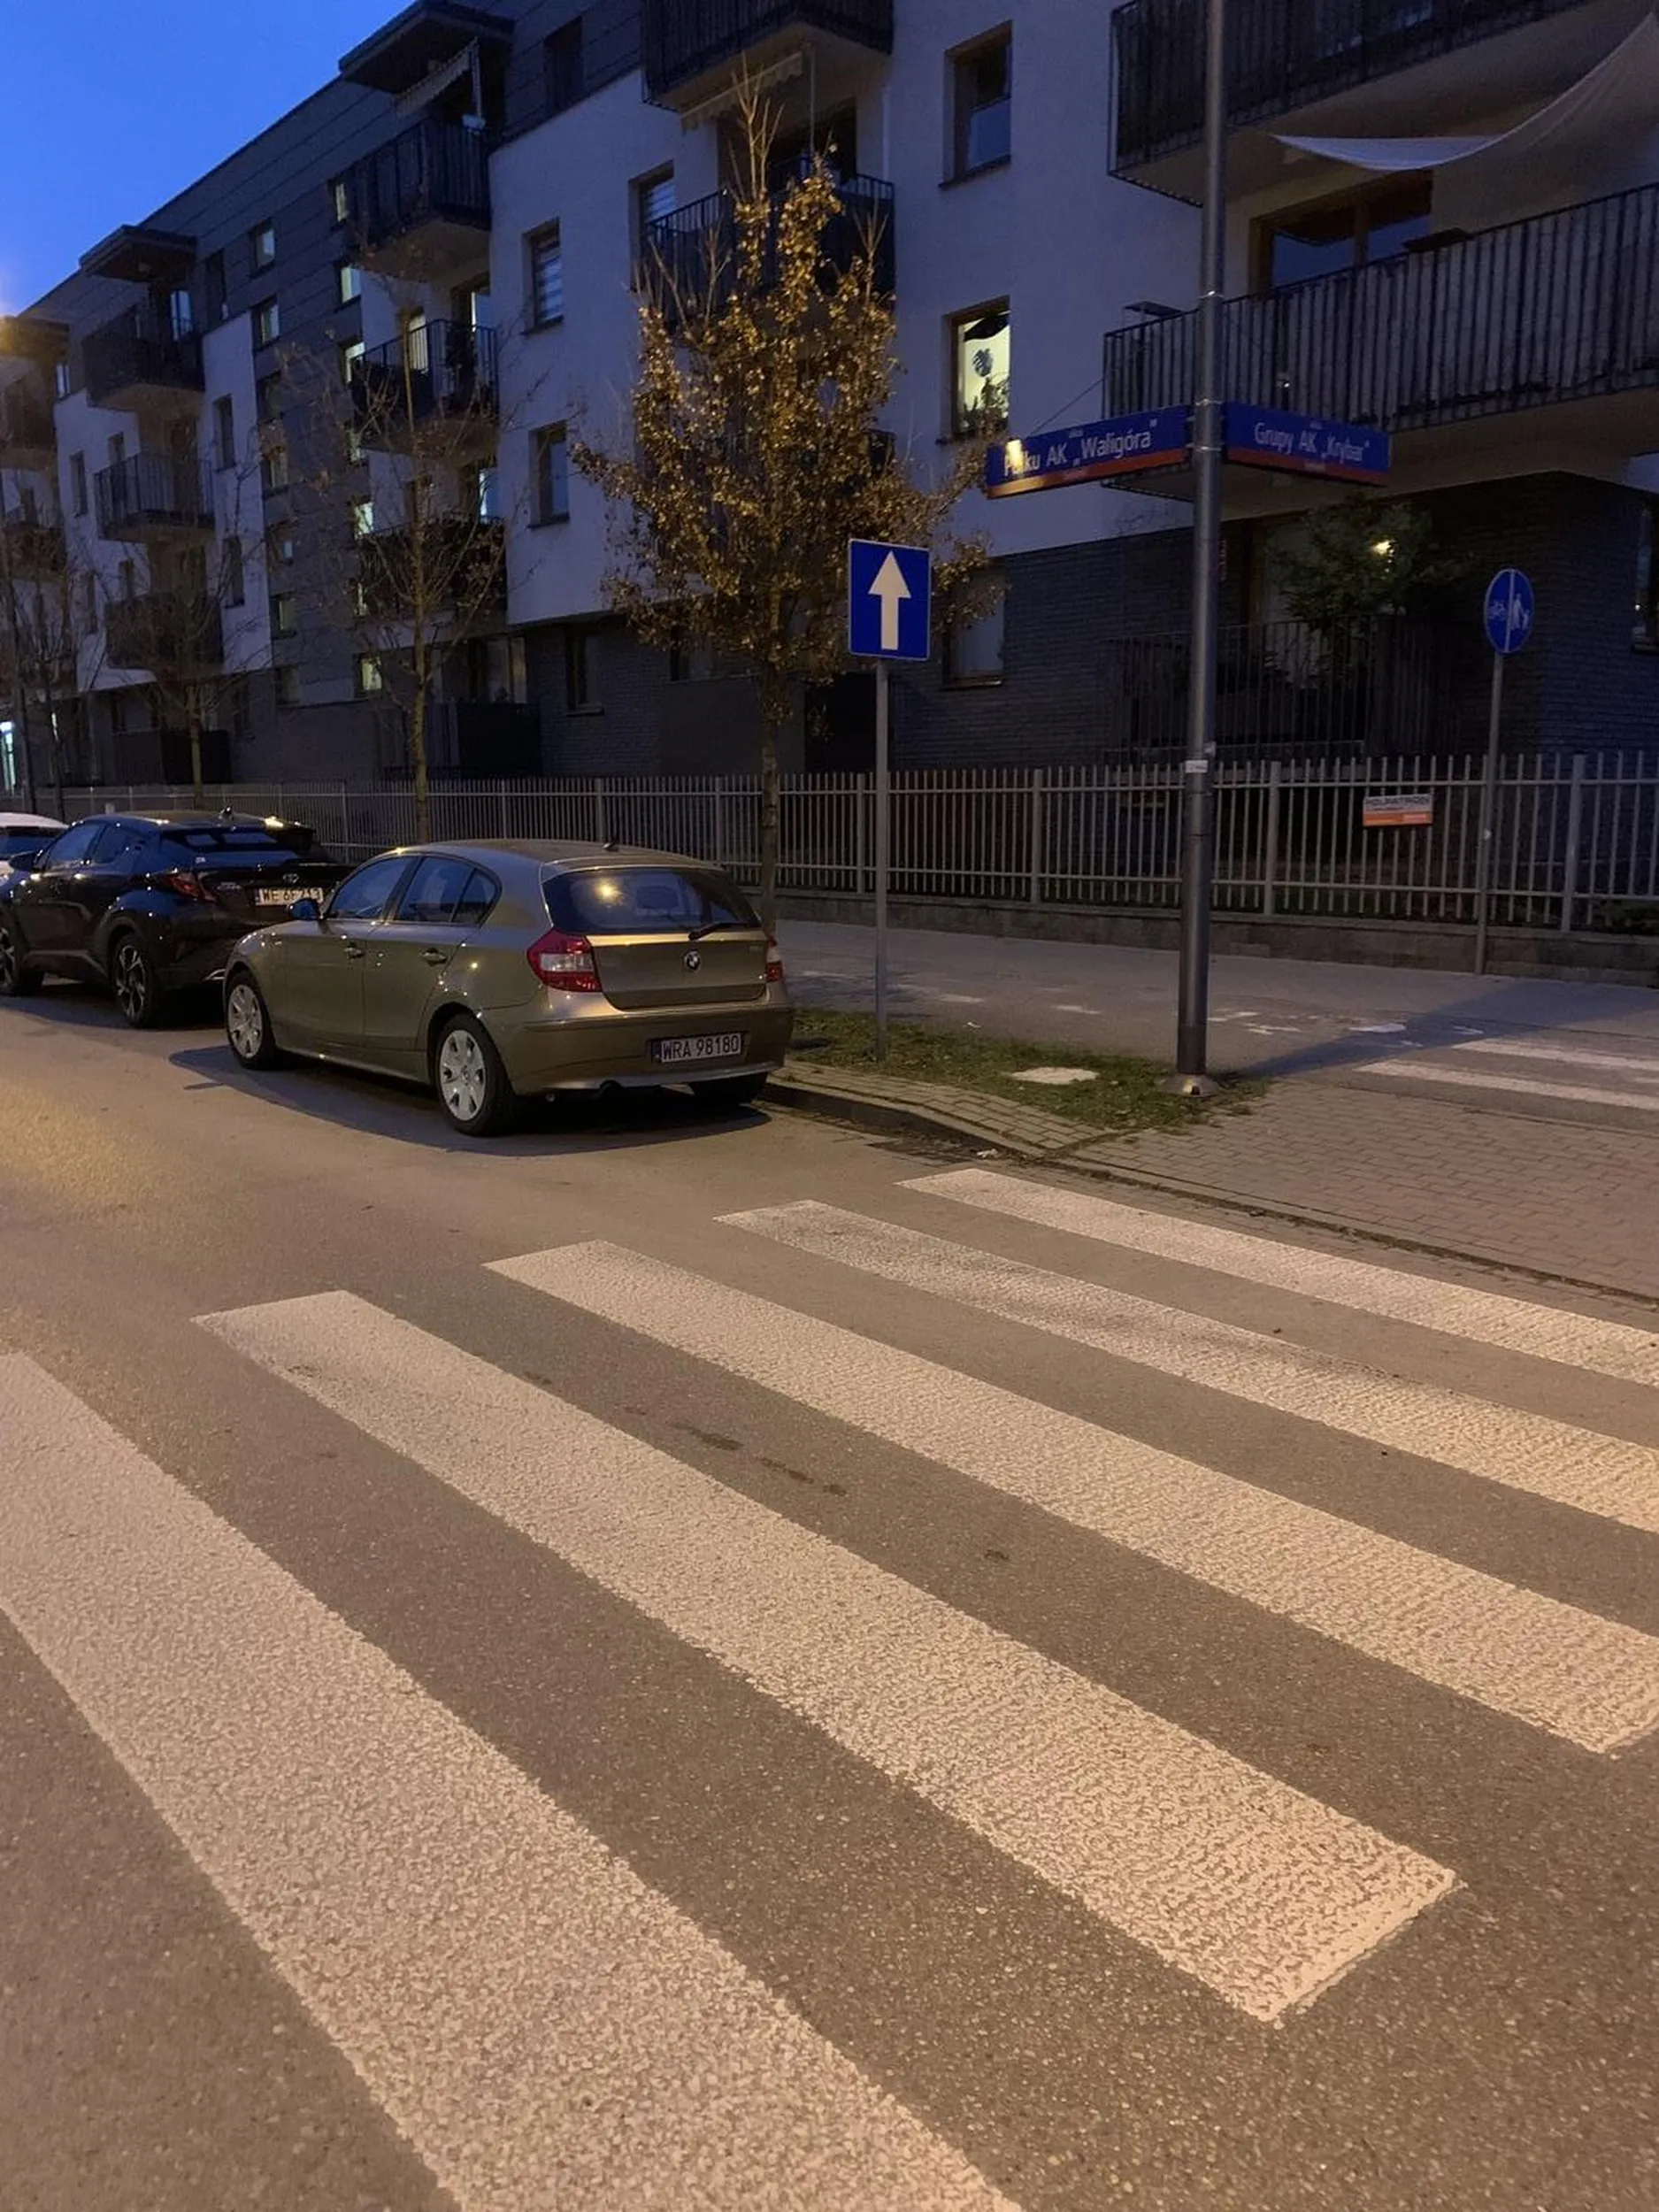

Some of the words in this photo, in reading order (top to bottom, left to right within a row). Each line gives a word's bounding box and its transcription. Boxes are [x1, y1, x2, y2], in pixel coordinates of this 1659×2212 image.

[1255, 421, 1294, 455] Grupy
[1299, 430, 1317, 453] AK
[1004, 450, 1041, 477] Pku
[1047, 443, 1067, 467] AK
[663, 1040, 691, 1060] WRA
[695, 1034, 740, 1057] 98180
